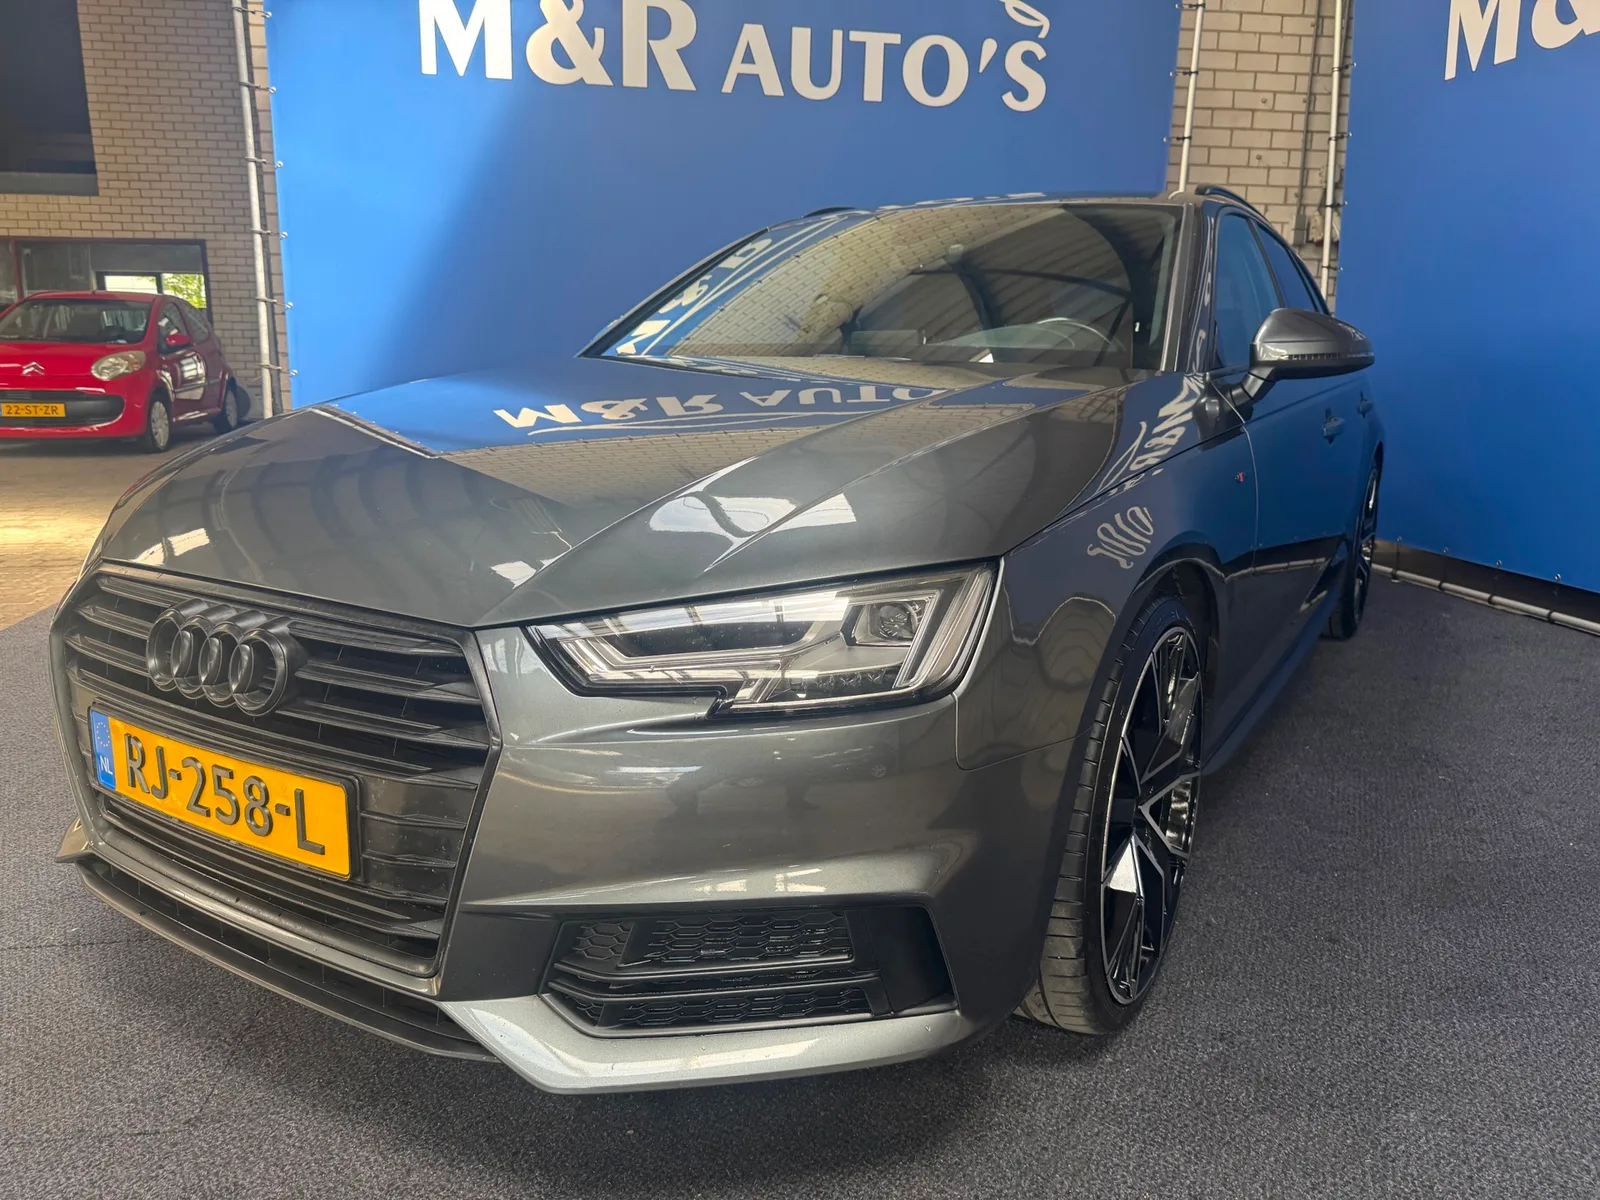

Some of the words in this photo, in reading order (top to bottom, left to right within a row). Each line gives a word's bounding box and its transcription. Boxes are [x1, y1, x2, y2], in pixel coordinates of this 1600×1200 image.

[418, 0, 697, 92] M&R
[720, 22, 1048, 113] AUTO'S
[5, 404, 59, 415] 22-ST-ZR
[99, 756, 114, 776] NL
[123, 732, 326, 856] RJ-258-L
